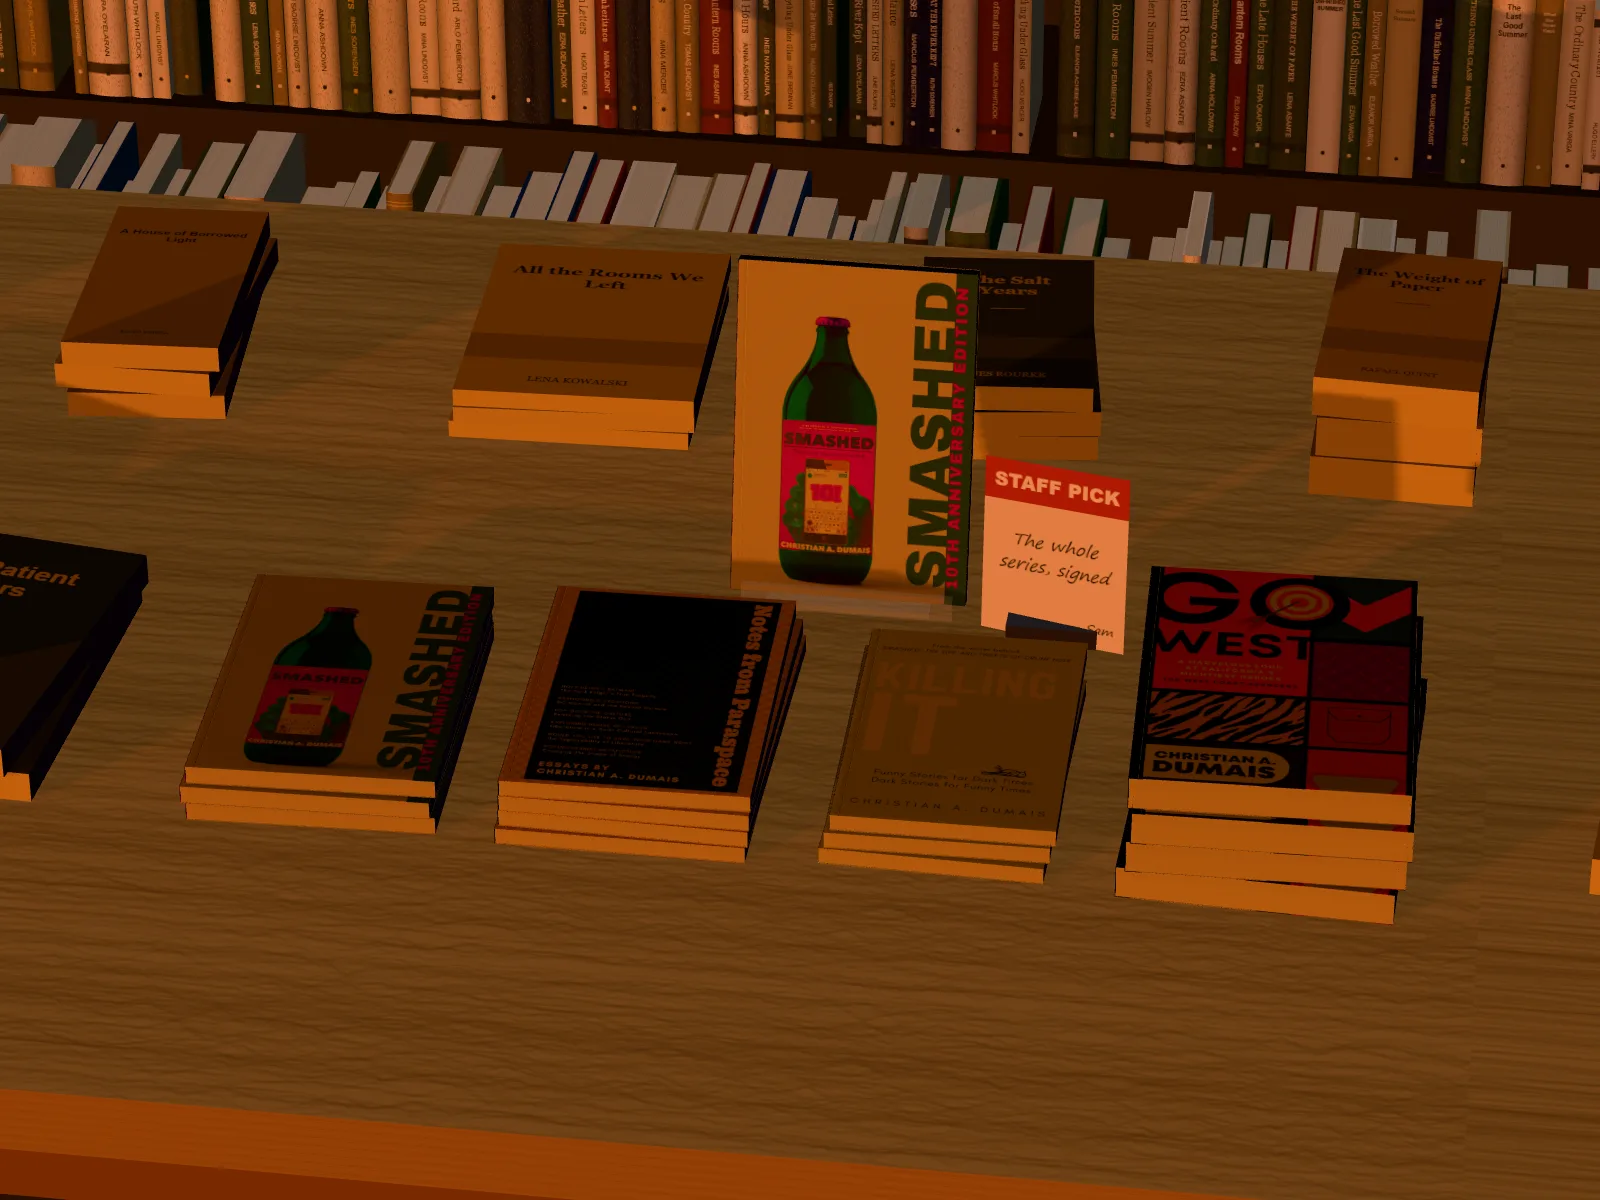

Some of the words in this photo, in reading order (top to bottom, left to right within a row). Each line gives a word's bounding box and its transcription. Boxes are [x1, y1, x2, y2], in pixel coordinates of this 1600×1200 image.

[291, 3, 299, 34] SAOIRSE
[578, 5, 589, 35] Letters
[681, 3, 692, 36] Country
[741, 4, 751, 34] Hours
[854, 0, 864, 21] River
[992, 1, 1001, 10] of
[1236, 0, 1245, 30] antern
[1258, 10, 1269, 31] Late
[1352, 11, 1363, 29] Last
[1505, 12, 1521, 20] Last
[1575, 4, 1586, 22] The
[102, 13, 110, 57] OYELARAN
[852, 23, 864, 44] Kept
[1112, 3, 1122, 41] Rooms
[1371, 11, 1383, 50] Borrowed
[293, 35, 301, 73] LINDQVIST
[320, 31, 328, 72] ASHDOWN
[684, 43, 692, 66] TOMAS
[711, 26, 722, 55] Rooms
[992, 31, 1000, 52] Hours
[1146, 21, 1157, 64] Summer
[1178, 26, 1190, 65] Rooms
[1234, 32, 1245, 65] Rooms
[1257, 34, 1269, 71] Houses
[1351, 32, 1362, 56] Good
[1467, 28, 1476, 56] UNDER
[1570, 25, 1584, 68] Ordinary
[253, 40, 262, 75] SORENSEN
[351, 35, 359, 77] SORENSEN
[456, 39, 464, 85] PEMBERTON
[1369, 53, 1380, 87] Weather
[1466, 57, 1474, 81] GLASS
[660, 60, 668, 95] MERCER
[685, 67, 693, 102] LINDQVIST
[1348, 58, 1360, 97] Summer
[1567, 70, 1580, 110] Country
[1110, 69, 1118, 120] PEMBERTON
[1368, 96, 1376, 125] ELEANOR
[1366, 126, 1374, 147] VARGA
[1462, 106, 1470, 147] LINDQVIST
[514, 265, 543, 275] All
[550, 267, 583, 276] the
[588, 268, 662, 280] Rooms
[670, 272, 704, 282] We
[584, 279, 626, 290] Left
[979, 275, 1006, 284] he
[1010, 276, 1052, 286] Salt
[1356, 267, 1388, 277] The
[1395, 270, 1461, 285] Weight
[1465, 278, 1487, 286] of
[1389, 280, 1445, 292] Paper
[980, 286, 1038, 296] Years
[953, 287, 970, 374] EDITION
[527, 375, 560, 384] LENA
[563, 377, 629, 387] KOWALSKI
[996, 371, 1047, 379] ROURKE
[784, 432, 874, 450] SMASHED
[905, 282, 957, 588] SMASHED
[946, 383, 966, 531] ANNIVERSARY
[994, 470, 1062, 496] STAFF
[1067, 482, 1121, 508] PICK
[780, 541, 825, 552] CHRISTIAN
[837, 547, 871, 555] DUMAIS
[1015, 532, 1045, 550] The
[1051, 541, 1099, 560] whole
[945, 538, 961, 589] 10TH
[999, 555, 1051, 576] series,
[1056, 565, 1114, 586] signed
[1159, 571, 1350, 630] GO
[744, 604, 774, 651] Notes
[1155, 629, 1312, 661] WEST
[272, 671, 365, 686] SMASHED
[377, 590, 469, 770] SMASHED
[734, 652, 763, 696] from
[876, 661, 1057, 700] KILLING
[862, 692, 958, 755] IT
[711, 697, 751, 788] Paraspace
[1154, 750, 1254, 763] CHRISTIAN
[1258, 756, 1277, 765] A.
[536, 768, 605, 778] CHRISTIAN
[628, 773, 680, 783] DUMAIS
[538, 761, 589, 770] ESSAYS
[873, 768, 906, 779] Funny
[910, 771, 948, 781] Stories
[973, 775, 997, 785] Dark
[1003, 777, 1035, 786] Times
[1152, 759, 1276, 779] DUMAIS
[871, 776, 896, 785] Dark
[901, 778, 939, 788] Stories
[944, 780, 960, 789] for
[964, 783, 996, 793] Funny
[1000, 786, 1031, 795] Times
[850, 797, 942, 810] CHRISTIAN
[953, 804, 969, 812] A.
[980, 806, 1046, 818] DUMAIS
